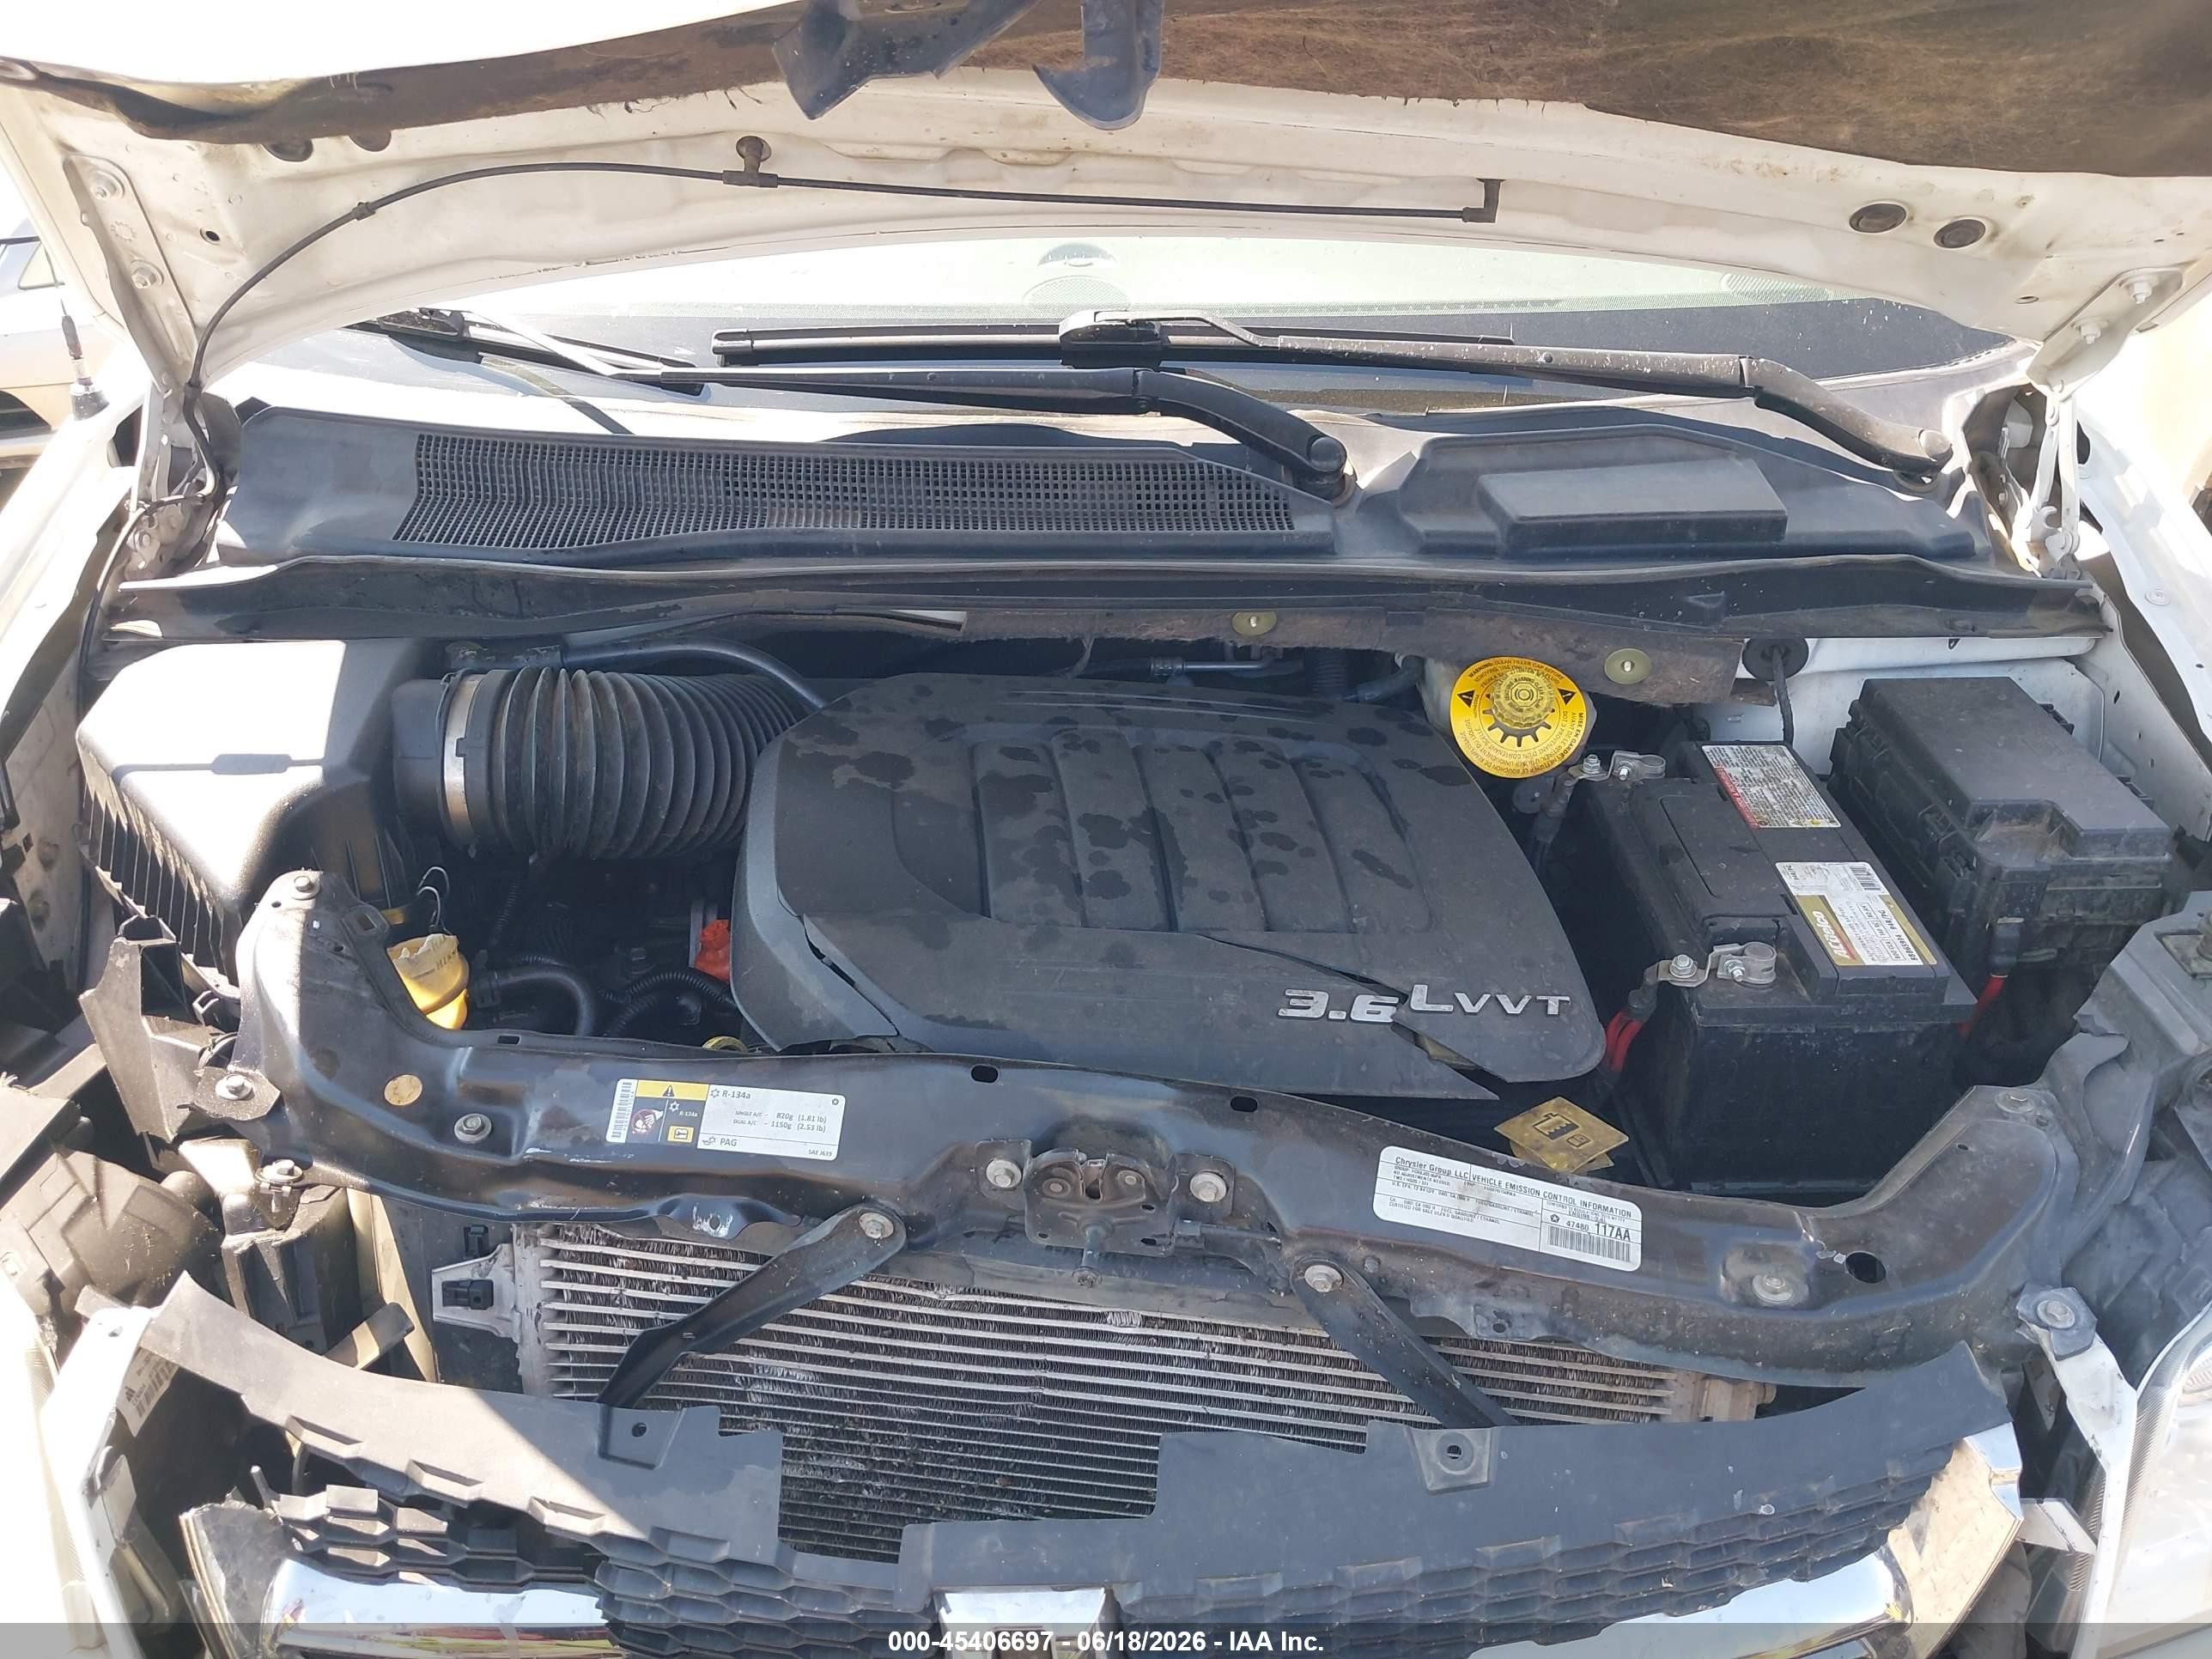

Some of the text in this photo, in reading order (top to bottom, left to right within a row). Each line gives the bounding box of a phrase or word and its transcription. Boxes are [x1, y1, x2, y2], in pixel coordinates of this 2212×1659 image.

[1574, 729, 1580, 738] EN
[722, 1090, 750, 1099] R-134a
[816, 1124, 826, 1133] lb)
[720, 1138, 738, 1147] PAG
[1395, 1156, 1427, 1169] Chrysler
[1429, 1164, 1452, 1176] Group
[1455, 1170, 1468, 1179] LLC
[1472, 1174, 1501, 1187] VEHICLE
[1505, 1182, 1540, 1196] EMISSION
[1543, 1191, 1577, 1205] CONTROL
[1580, 1200, 1632, 1218] INFORMATION
[1596, 1224, 1631, 1242] 117AA
